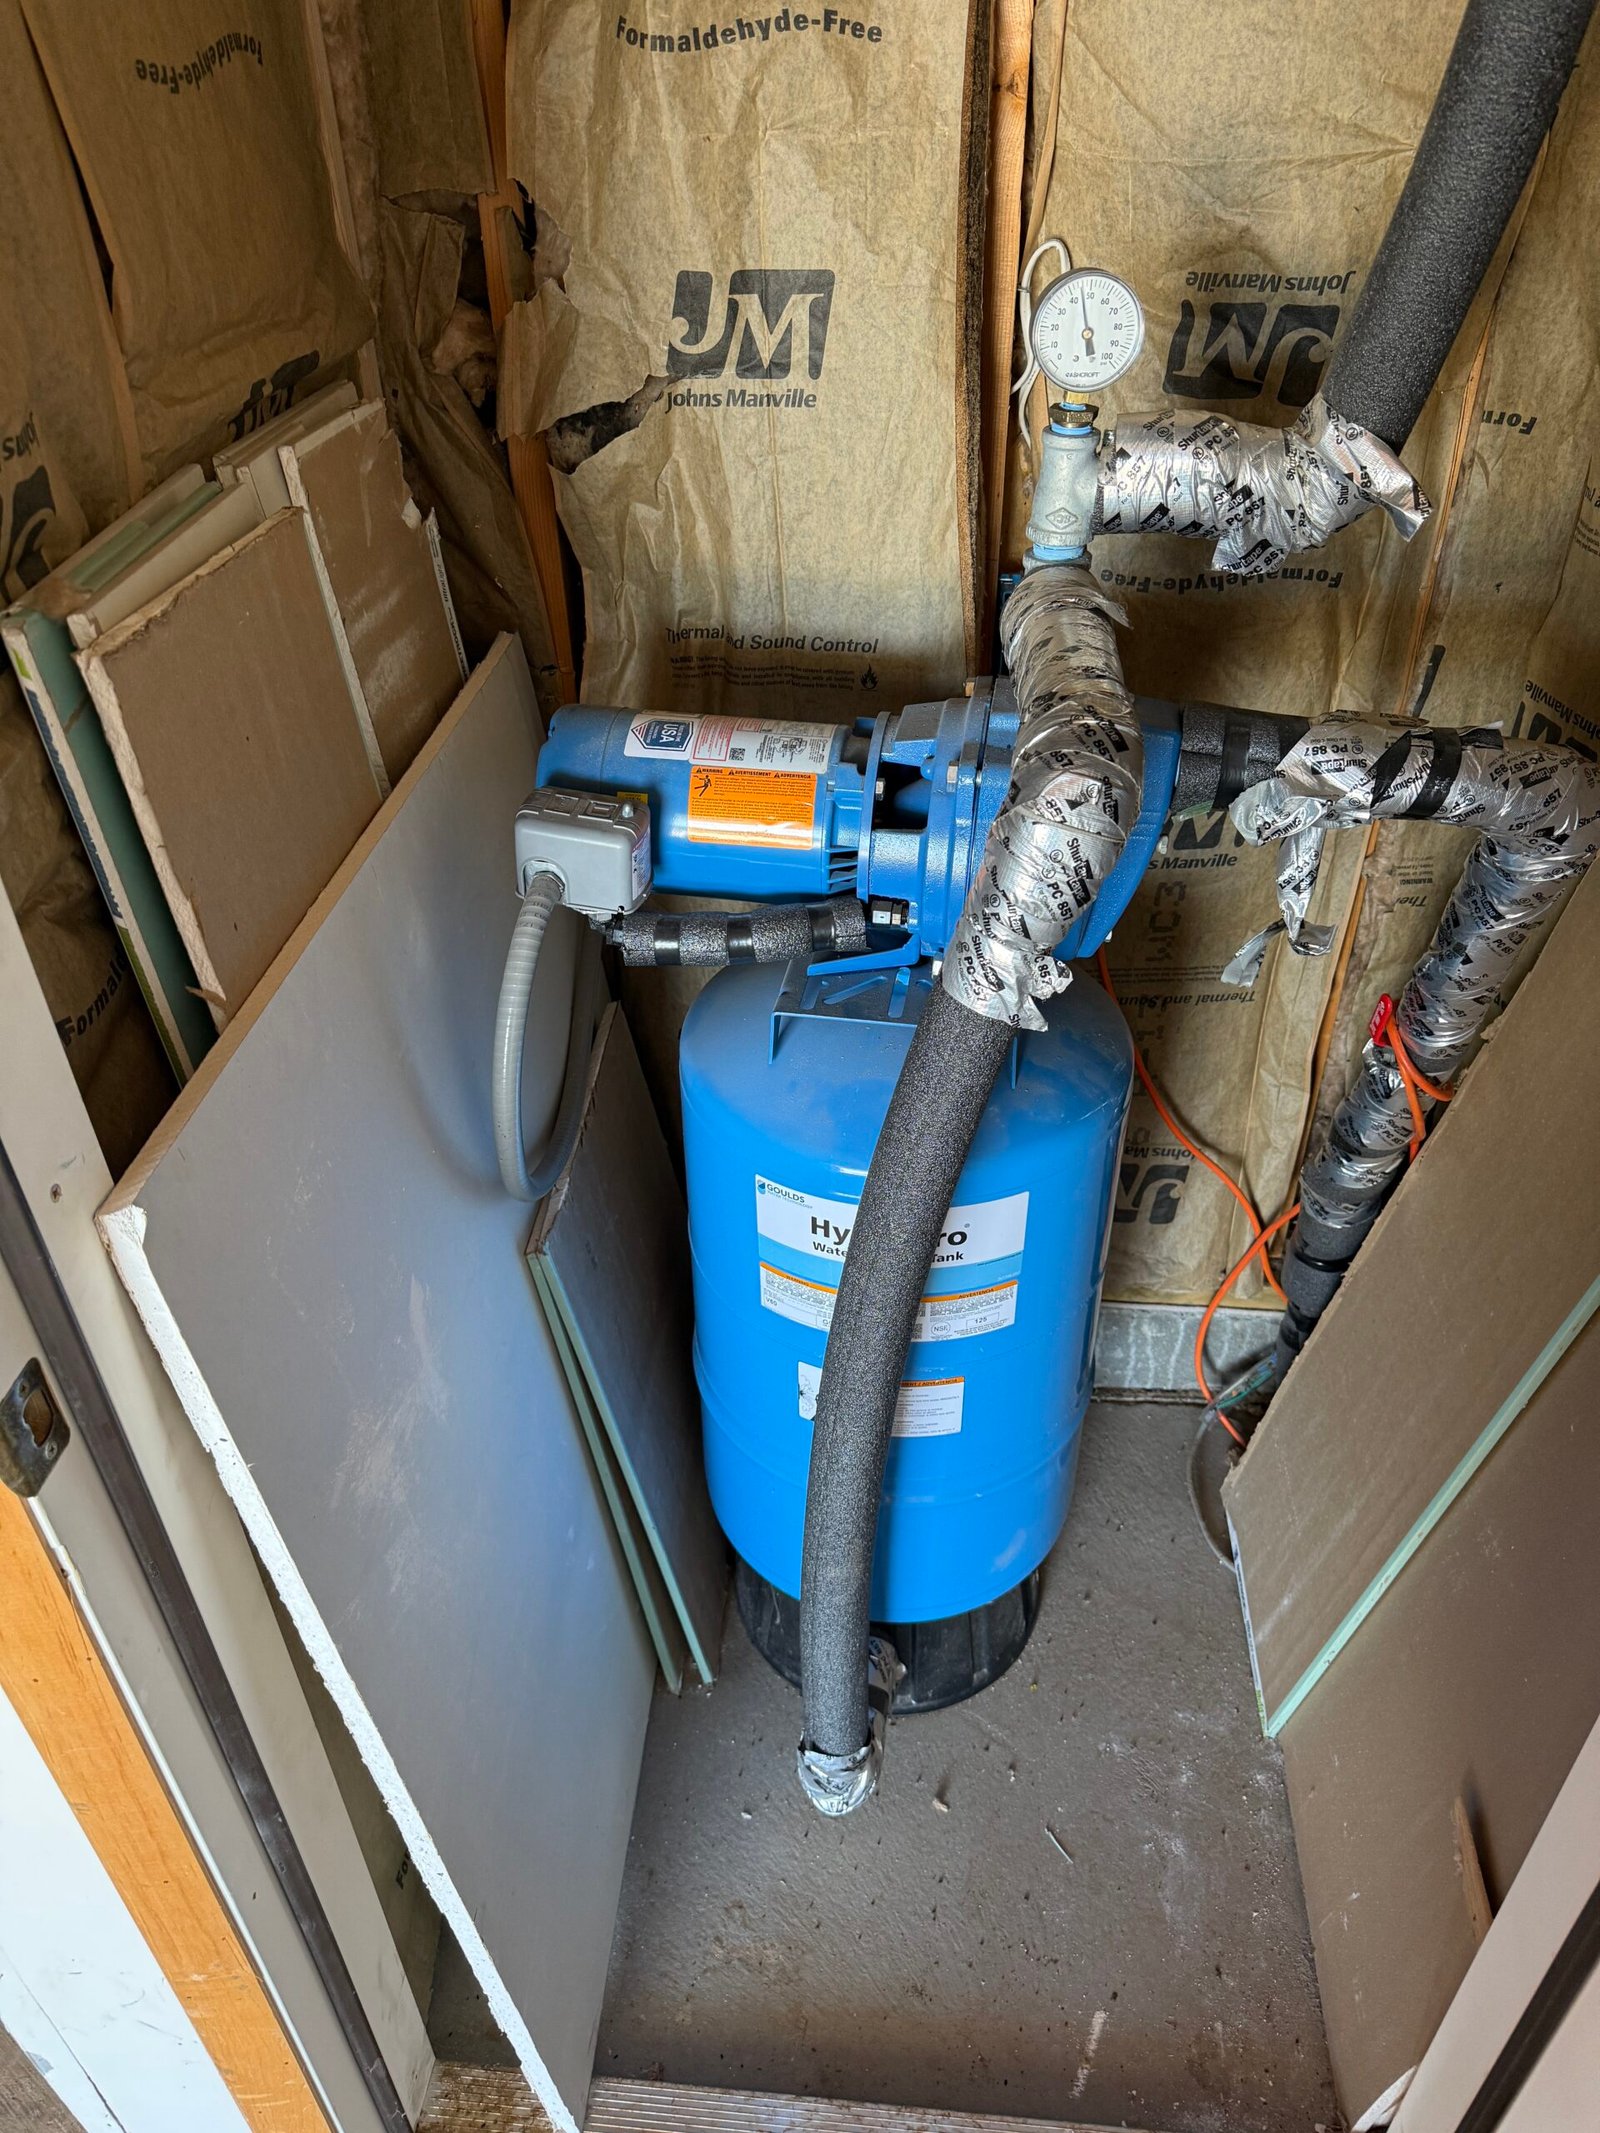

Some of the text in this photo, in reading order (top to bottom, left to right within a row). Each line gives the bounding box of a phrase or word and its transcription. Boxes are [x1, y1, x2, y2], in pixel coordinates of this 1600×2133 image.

[616, 8, 883, 53] Formaldehyde-Free
[135, 32, 264, 95] Formaldehyde-Free
[1185, 270, 1357, 296] Johns Manville
[1069, 296, 1079, 305] 40
[1086, 292, 1095, 300] 50
[1100, 297, 1110, 305] 60
[1057, 307, 1067, 316] 30
[1108, 307, 1119, 316] 70
[665, 269, 836, 381] JM
[1050, 323, 1060, 332] 20
[1113, 323, 1123, 331] 80
[1050, 341, 1058, 349] 10
[1110, 339, 1120, 348] 90
[1101, 352, 1114, 361] 100
[665, 388, 818, 414] Johns Manville
[1178, 415, 1225, 451] Shurtape
[1204, 434, 1223, 451] PC
[1360, 465, 1372, 489] 857
[1225, 513, 1244, 527] PC
[1244, 496, 1266, 516] 857
[1263, 548, 1286, 568] 857
[665, 625, 725, 644] Thermal
[749, 635, 806, 651] Sound
[810, 636, 879, 654] Control
[1524, 680, 1575, 727] Manville
[659, 723, 679, 743] USA
[1303, 744, 1328, 757] 857
[1331, 743, 1349, 753] PC
[1160, 853, 1238, 870] Manville
[1047, 882, 1074, 922] PC 857
[963, 956, 976, 976] PC
[1037, 965, 1053, 988] 857
[1161, 995, 1192, 1008] and
[1196, 990, 1256, 1006] Thermal
[766, 1183, 806, 1204] GOULDS
[812, 1241, 848, 1258] Wate
